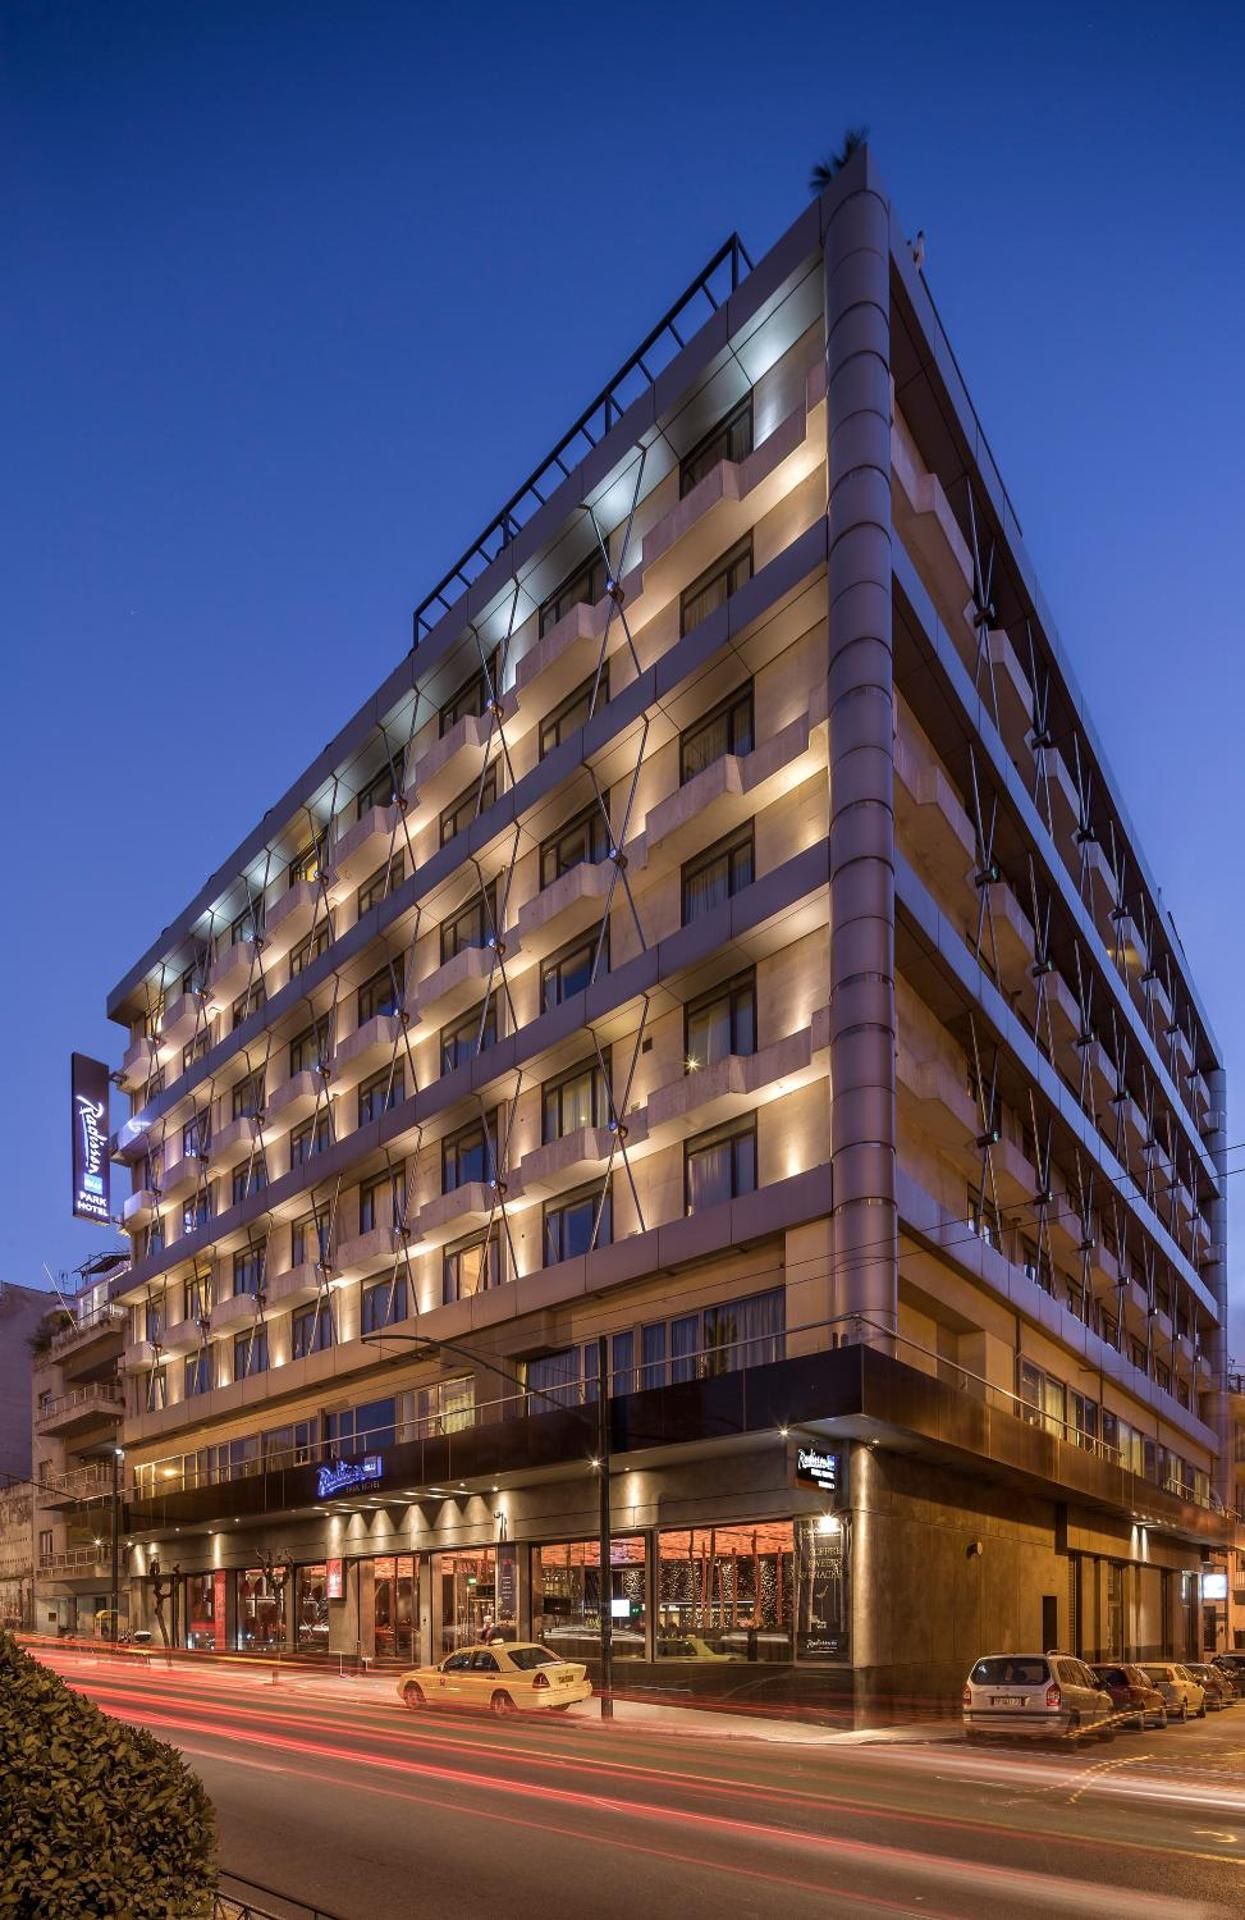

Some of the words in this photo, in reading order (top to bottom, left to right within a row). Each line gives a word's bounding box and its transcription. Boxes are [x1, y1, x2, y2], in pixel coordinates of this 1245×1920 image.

[76, 1095, 108, 1173] Radisson
[77, 1201, 108, 1217] HOTEL
[80, 1191, 107, 1207] PARK
[797, 1449, 827, 1469] Radisson
[317, 1461, 366, 1497] Radisson
